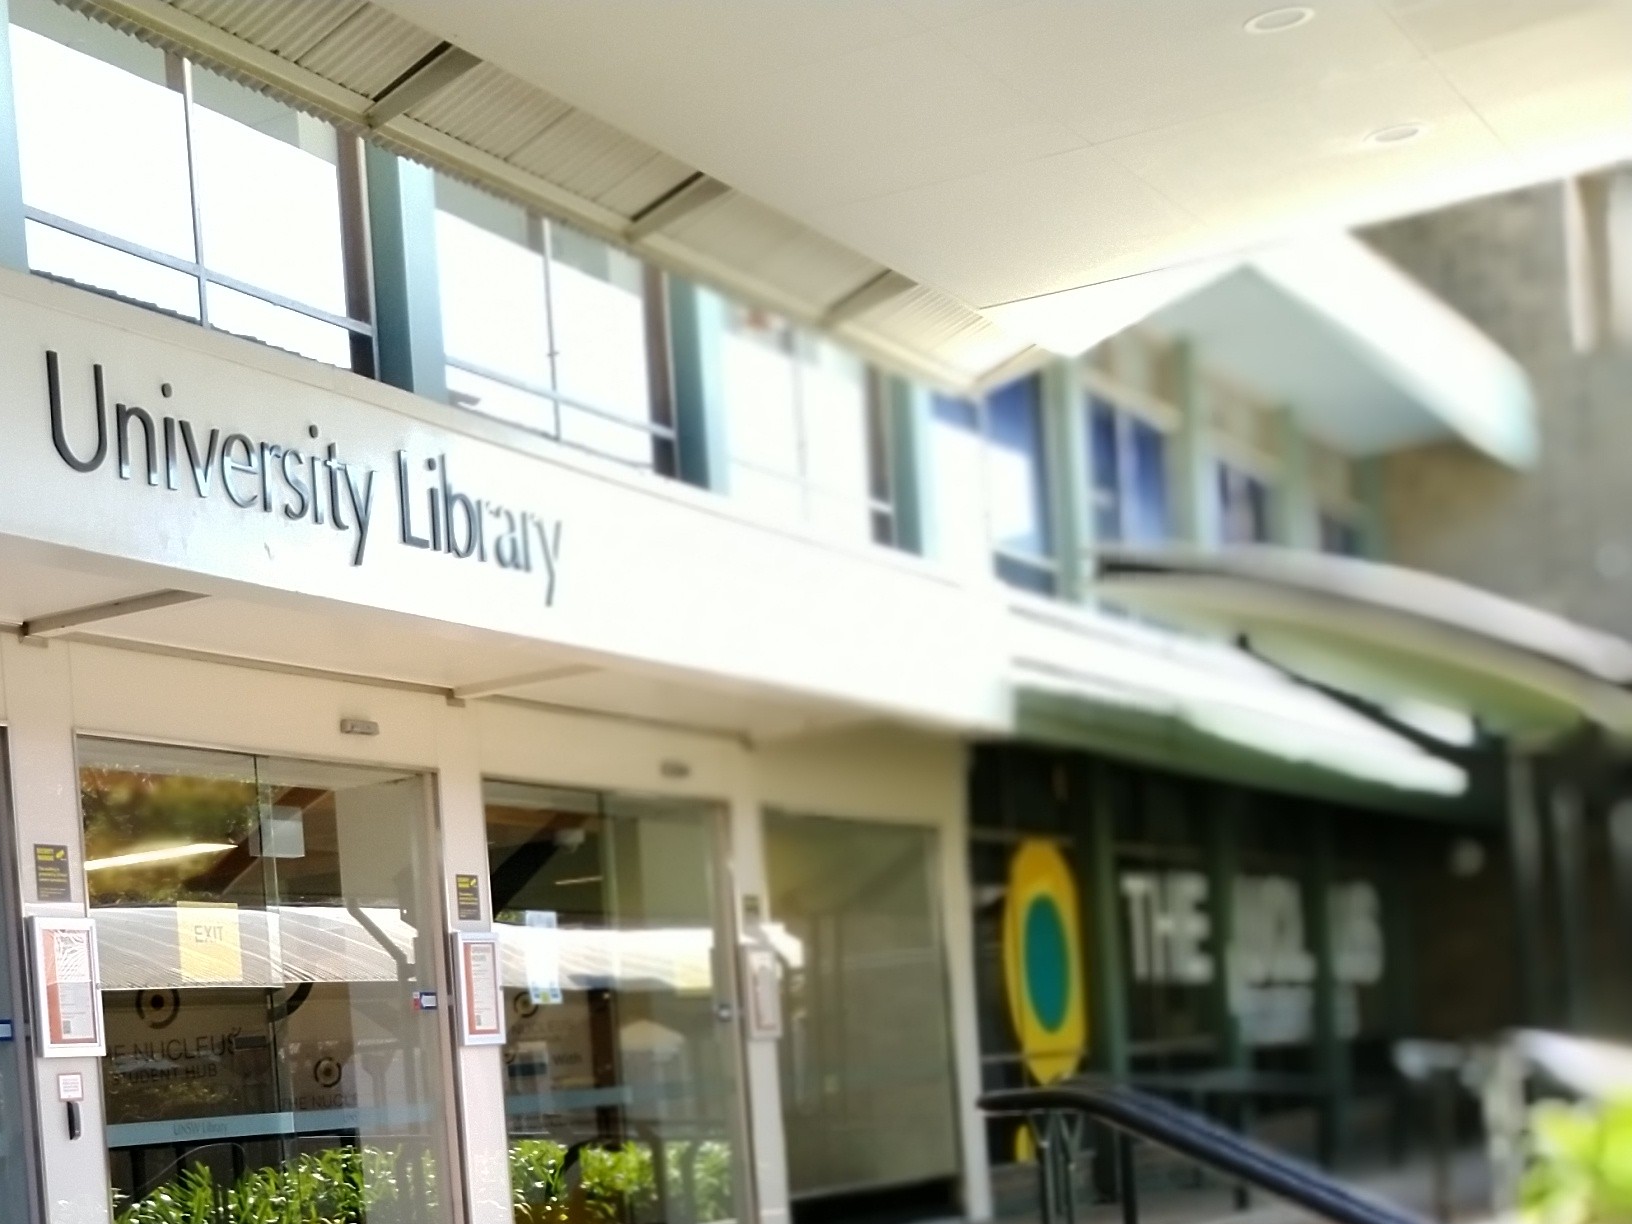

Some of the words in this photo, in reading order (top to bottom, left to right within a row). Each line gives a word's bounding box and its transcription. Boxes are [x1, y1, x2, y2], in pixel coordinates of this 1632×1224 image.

[45, 349, 377, 566] University
[396, 448, 563, 606] Library
[194, 924, 224, 943] EXIT
